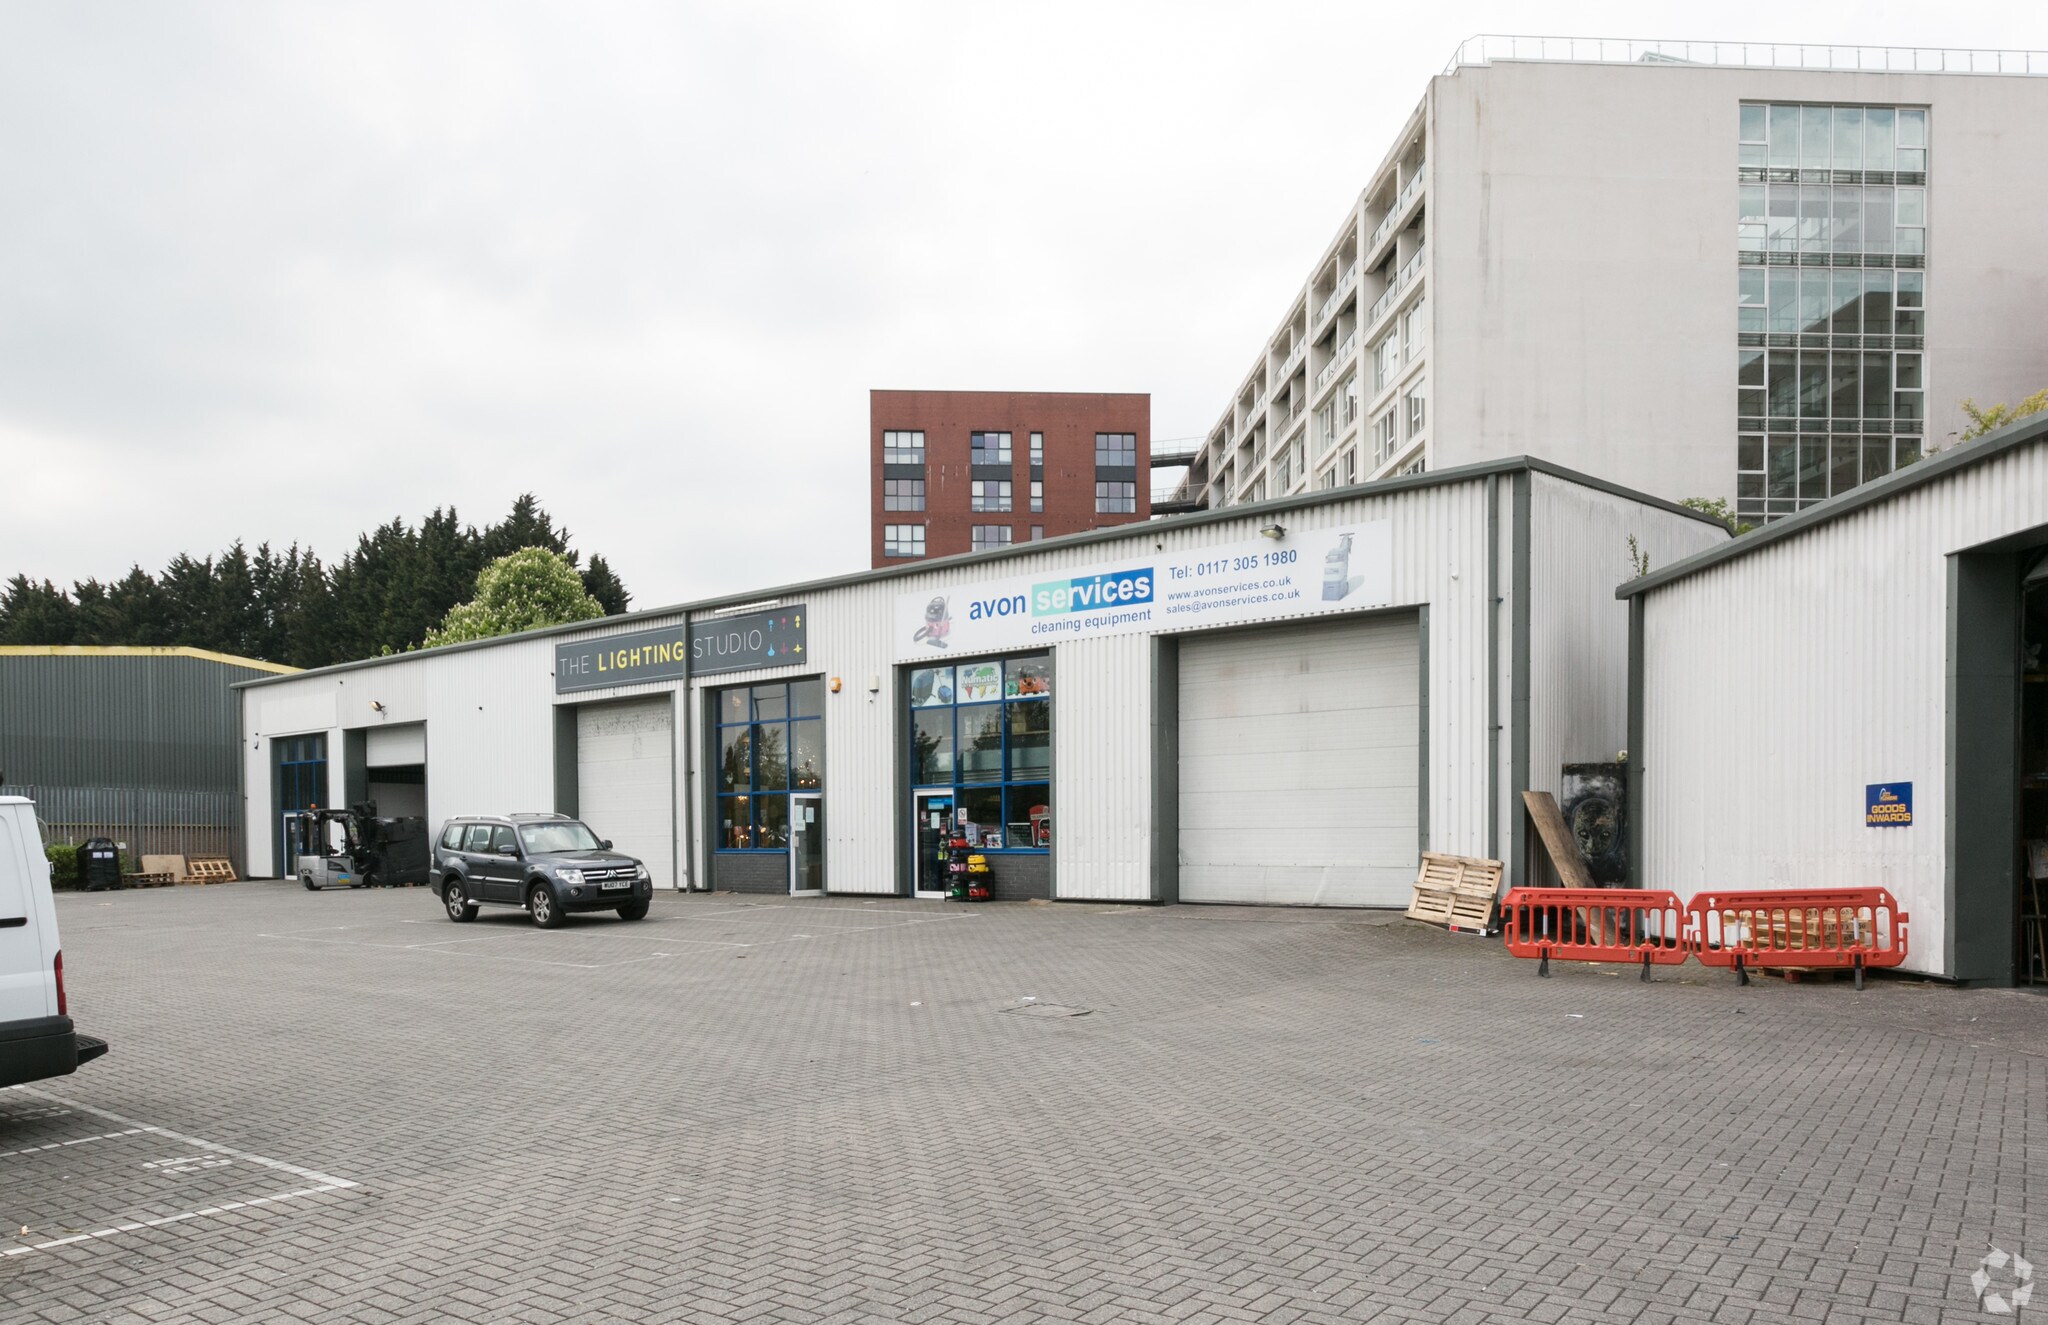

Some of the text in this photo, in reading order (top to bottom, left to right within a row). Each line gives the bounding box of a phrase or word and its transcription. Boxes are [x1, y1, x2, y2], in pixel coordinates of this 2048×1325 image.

[1169, 549, 1297, 580] Tel: 0117 305 1980
[969, 575, 1151, 620] avon services
[1166, 588, 1301, 614] sales@avonservices.co.uk
[1168, 576, 1292, 601] www.avonservices.co.uk
[1031, 609, 1152, 634] cleaning equipment
[560, 629, 762, 677] THE LIGHTING STUDIO
[1866, 813, 1911, 823] INWARDS
[1871, 803, 1906, 813] GOODS
